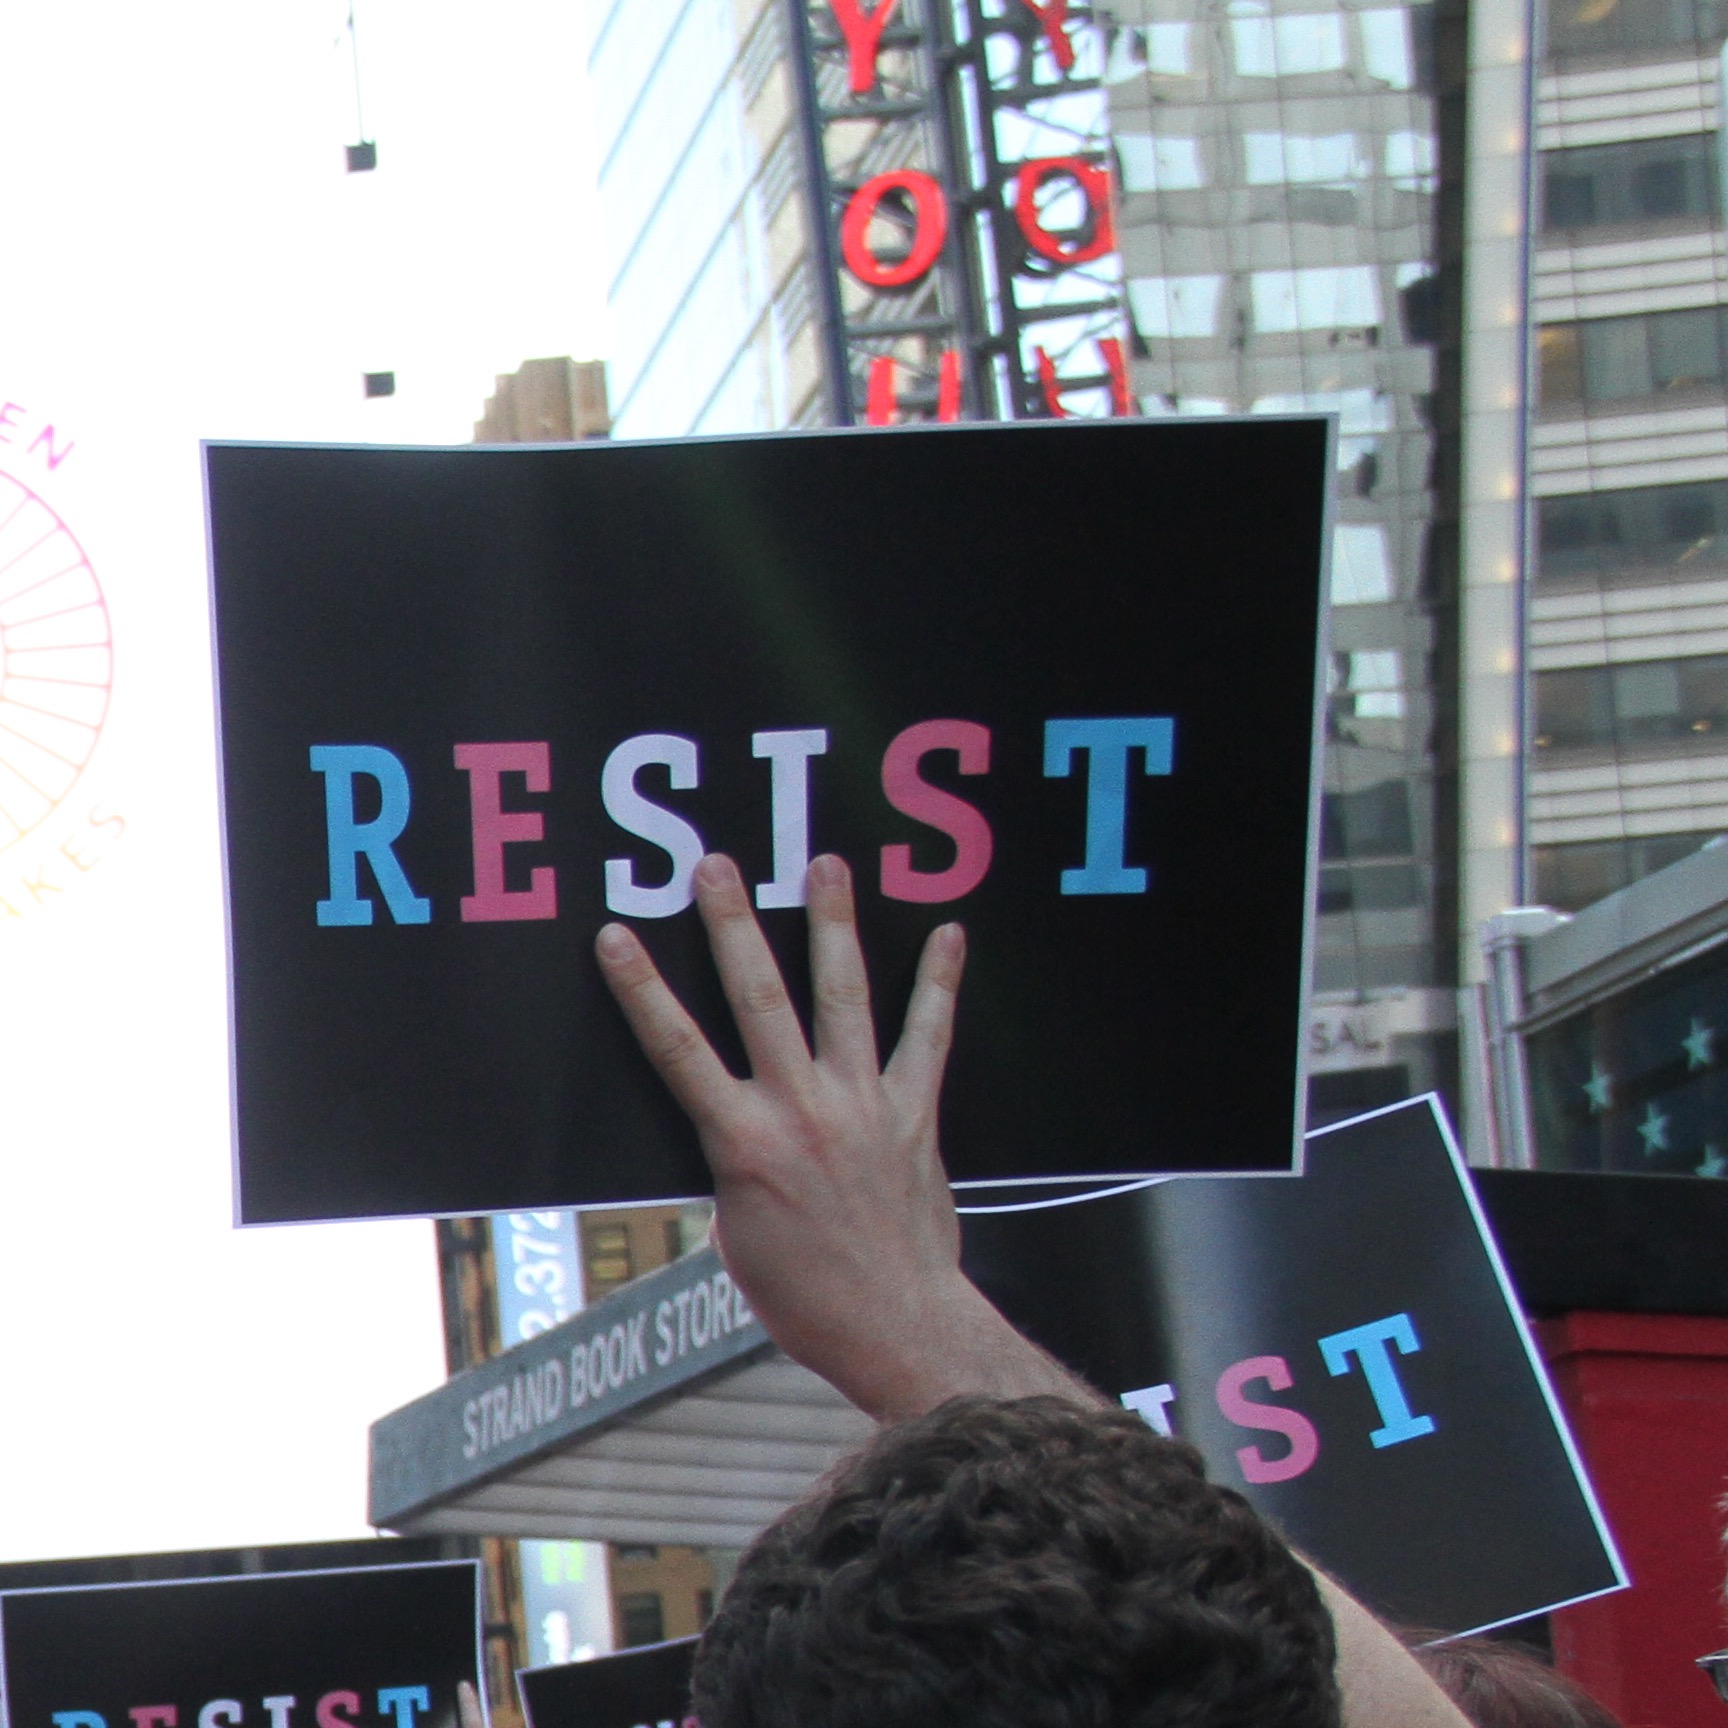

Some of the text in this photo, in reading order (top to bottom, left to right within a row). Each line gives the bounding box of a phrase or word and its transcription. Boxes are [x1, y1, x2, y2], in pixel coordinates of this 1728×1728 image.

[309, 717, 1174, 925] RESIST
[462, 1358, 566, 1460] STRAND
[569, 1308, 648, 1408] BOOK
